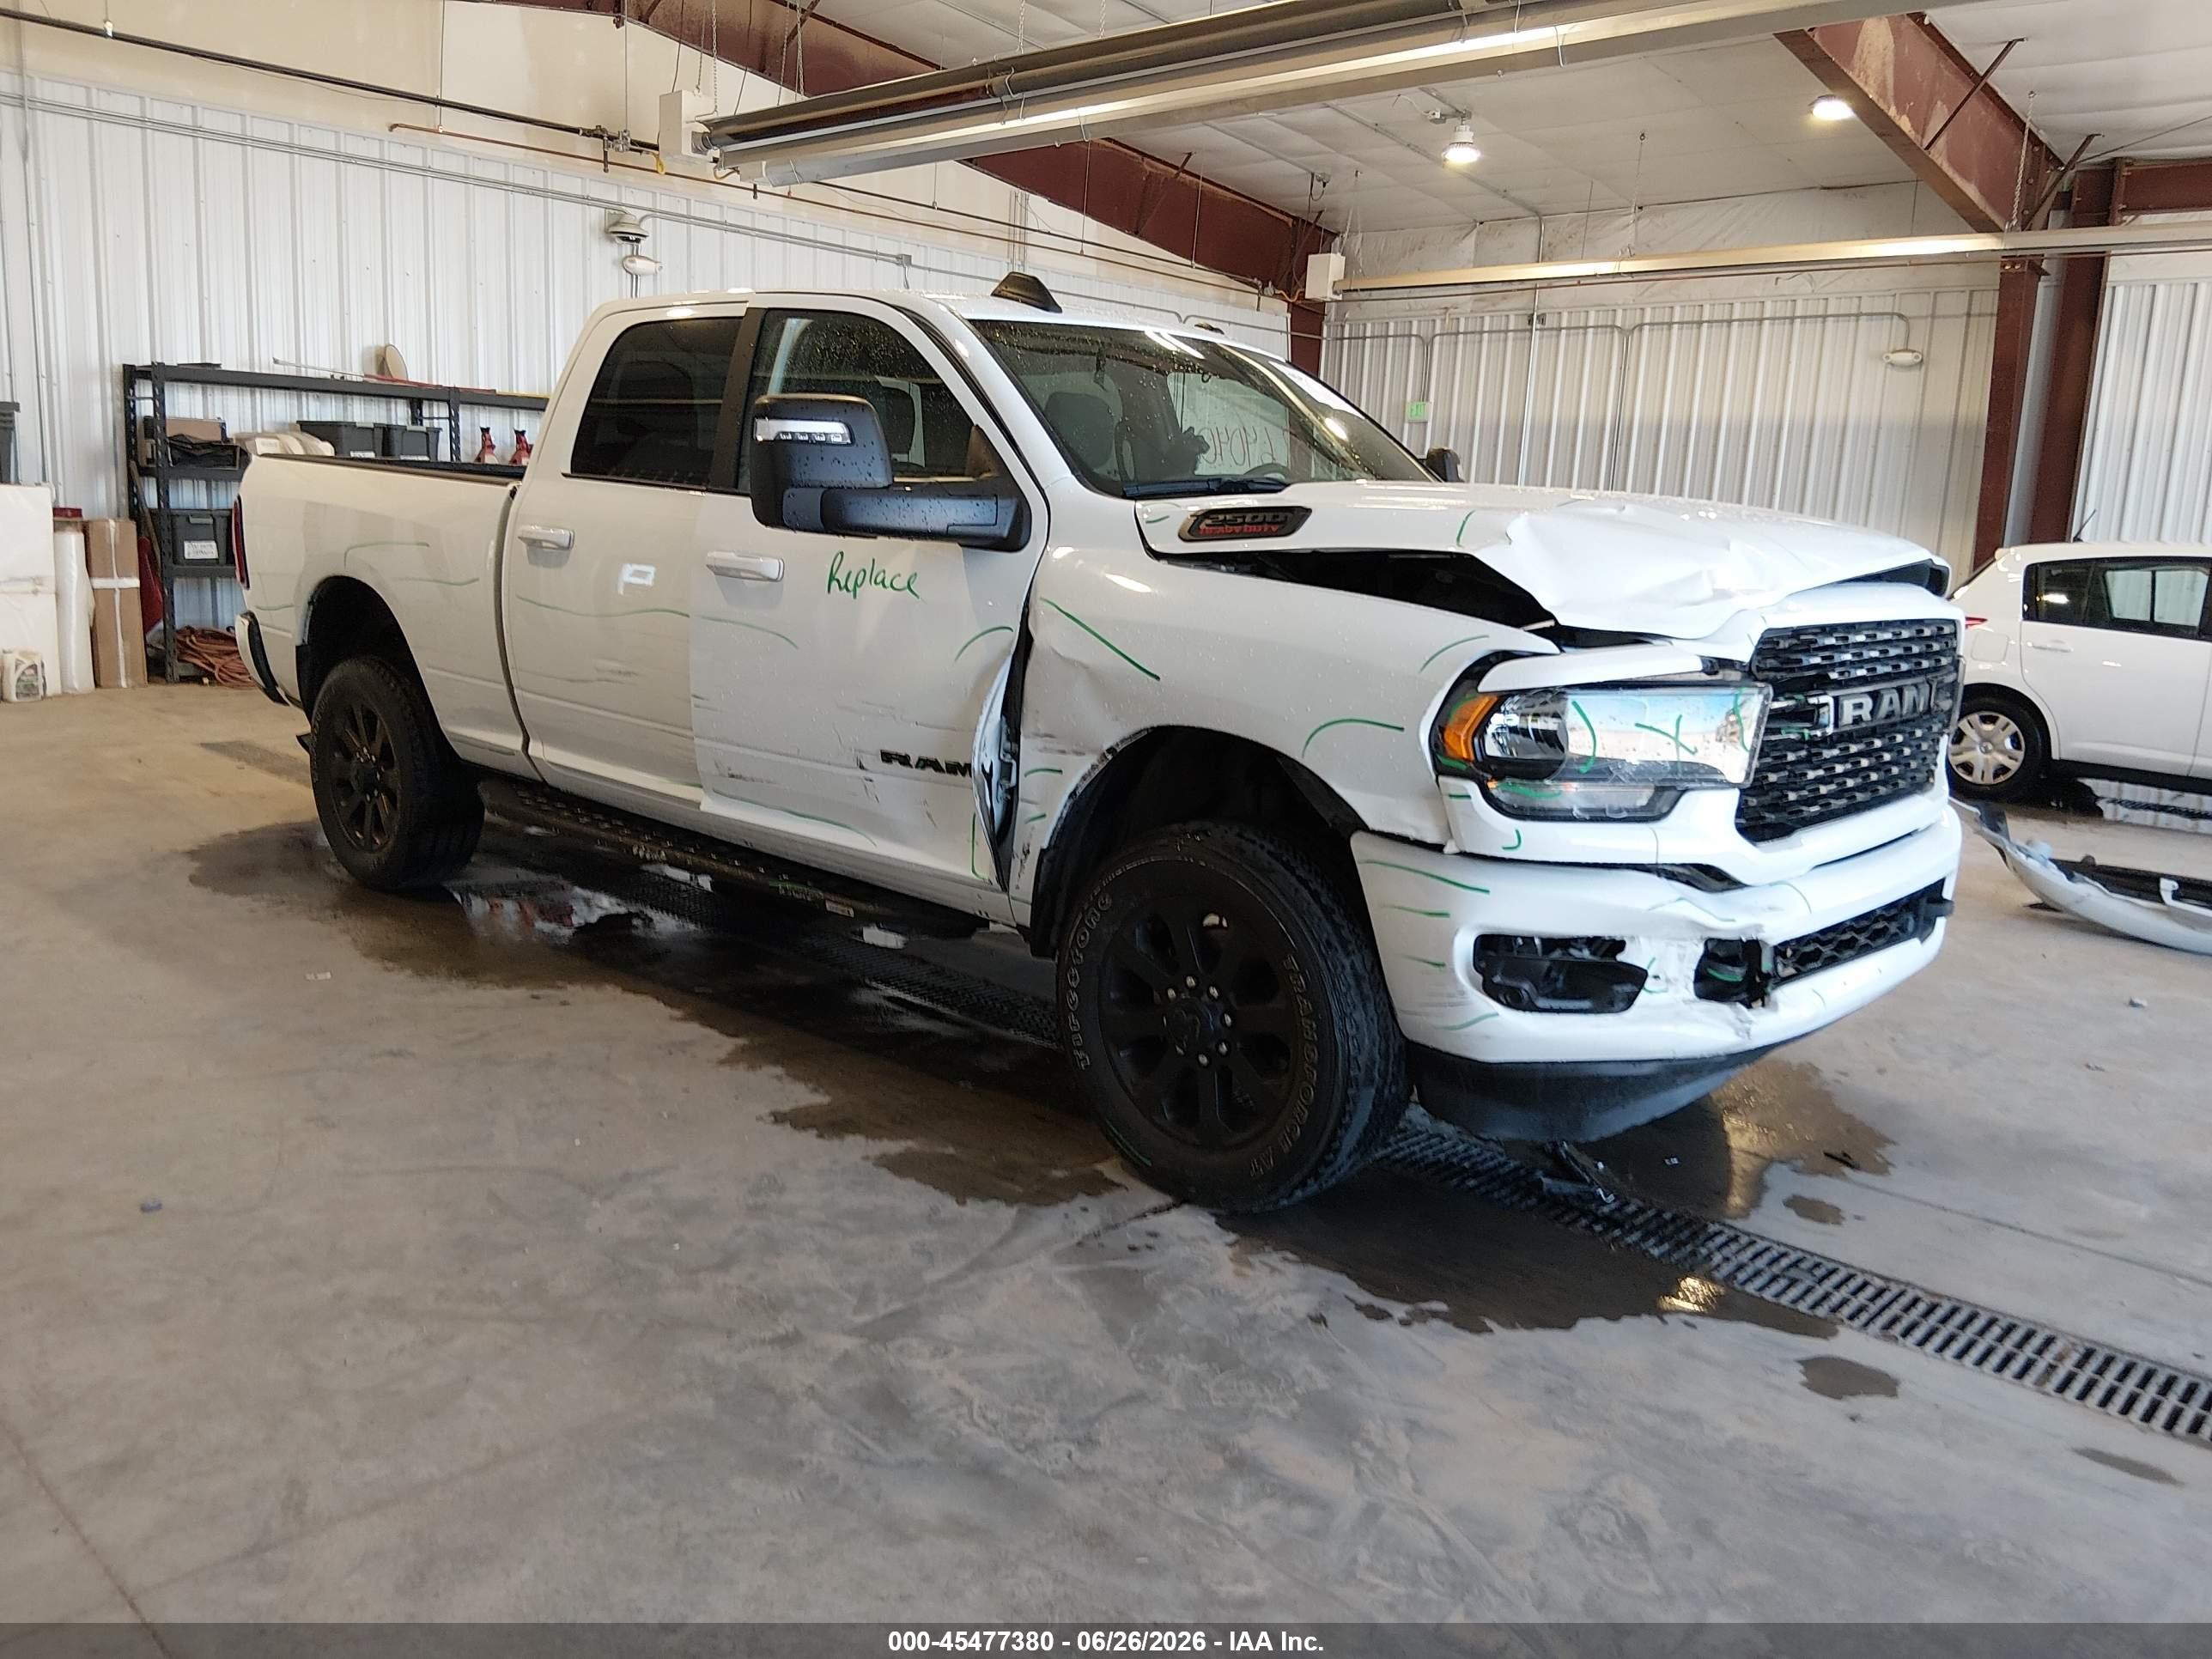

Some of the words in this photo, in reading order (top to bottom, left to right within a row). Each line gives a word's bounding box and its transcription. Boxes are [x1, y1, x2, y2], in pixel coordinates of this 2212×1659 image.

[1204, 513, 1286, 526] 2500
[827, 550, 921, 599] Replace
[1839, 684, 1931, 726] RAM
[880, 749, 973, 778] RAM
